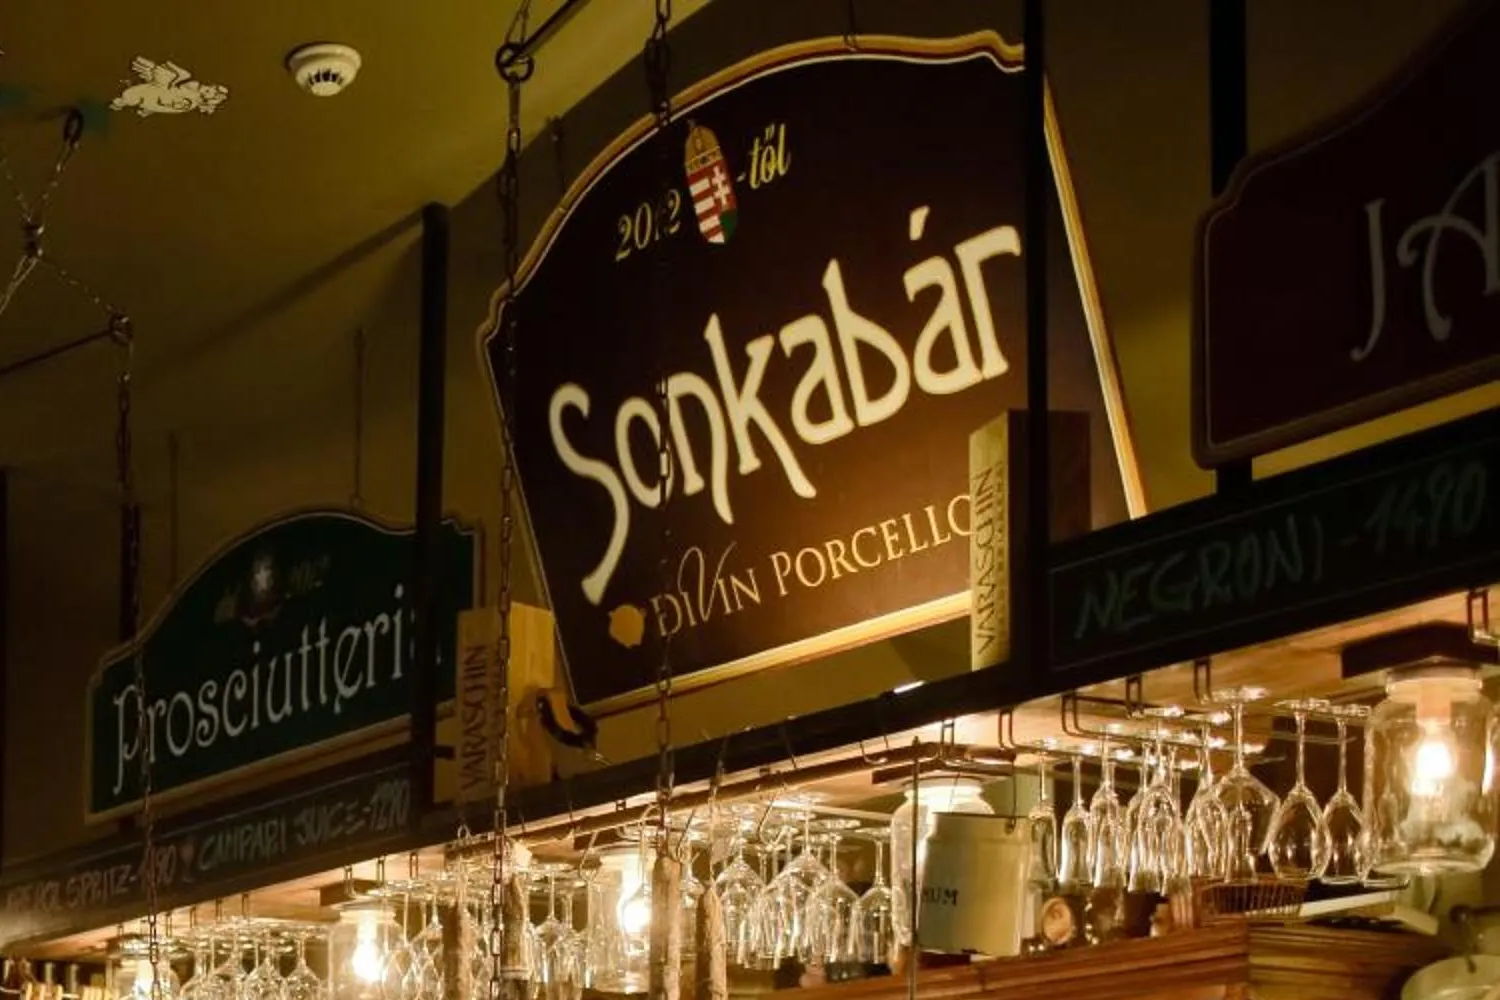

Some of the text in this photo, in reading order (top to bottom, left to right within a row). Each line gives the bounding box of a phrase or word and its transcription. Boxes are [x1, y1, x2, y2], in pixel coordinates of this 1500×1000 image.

[548, 204, 1022, 607] Sonkabár
[1073, 513, 1325, 641] NEGRONI
[112, 583, 442, 794] Prosciutteri
[197, 815, 287, 871] CAMPARI
